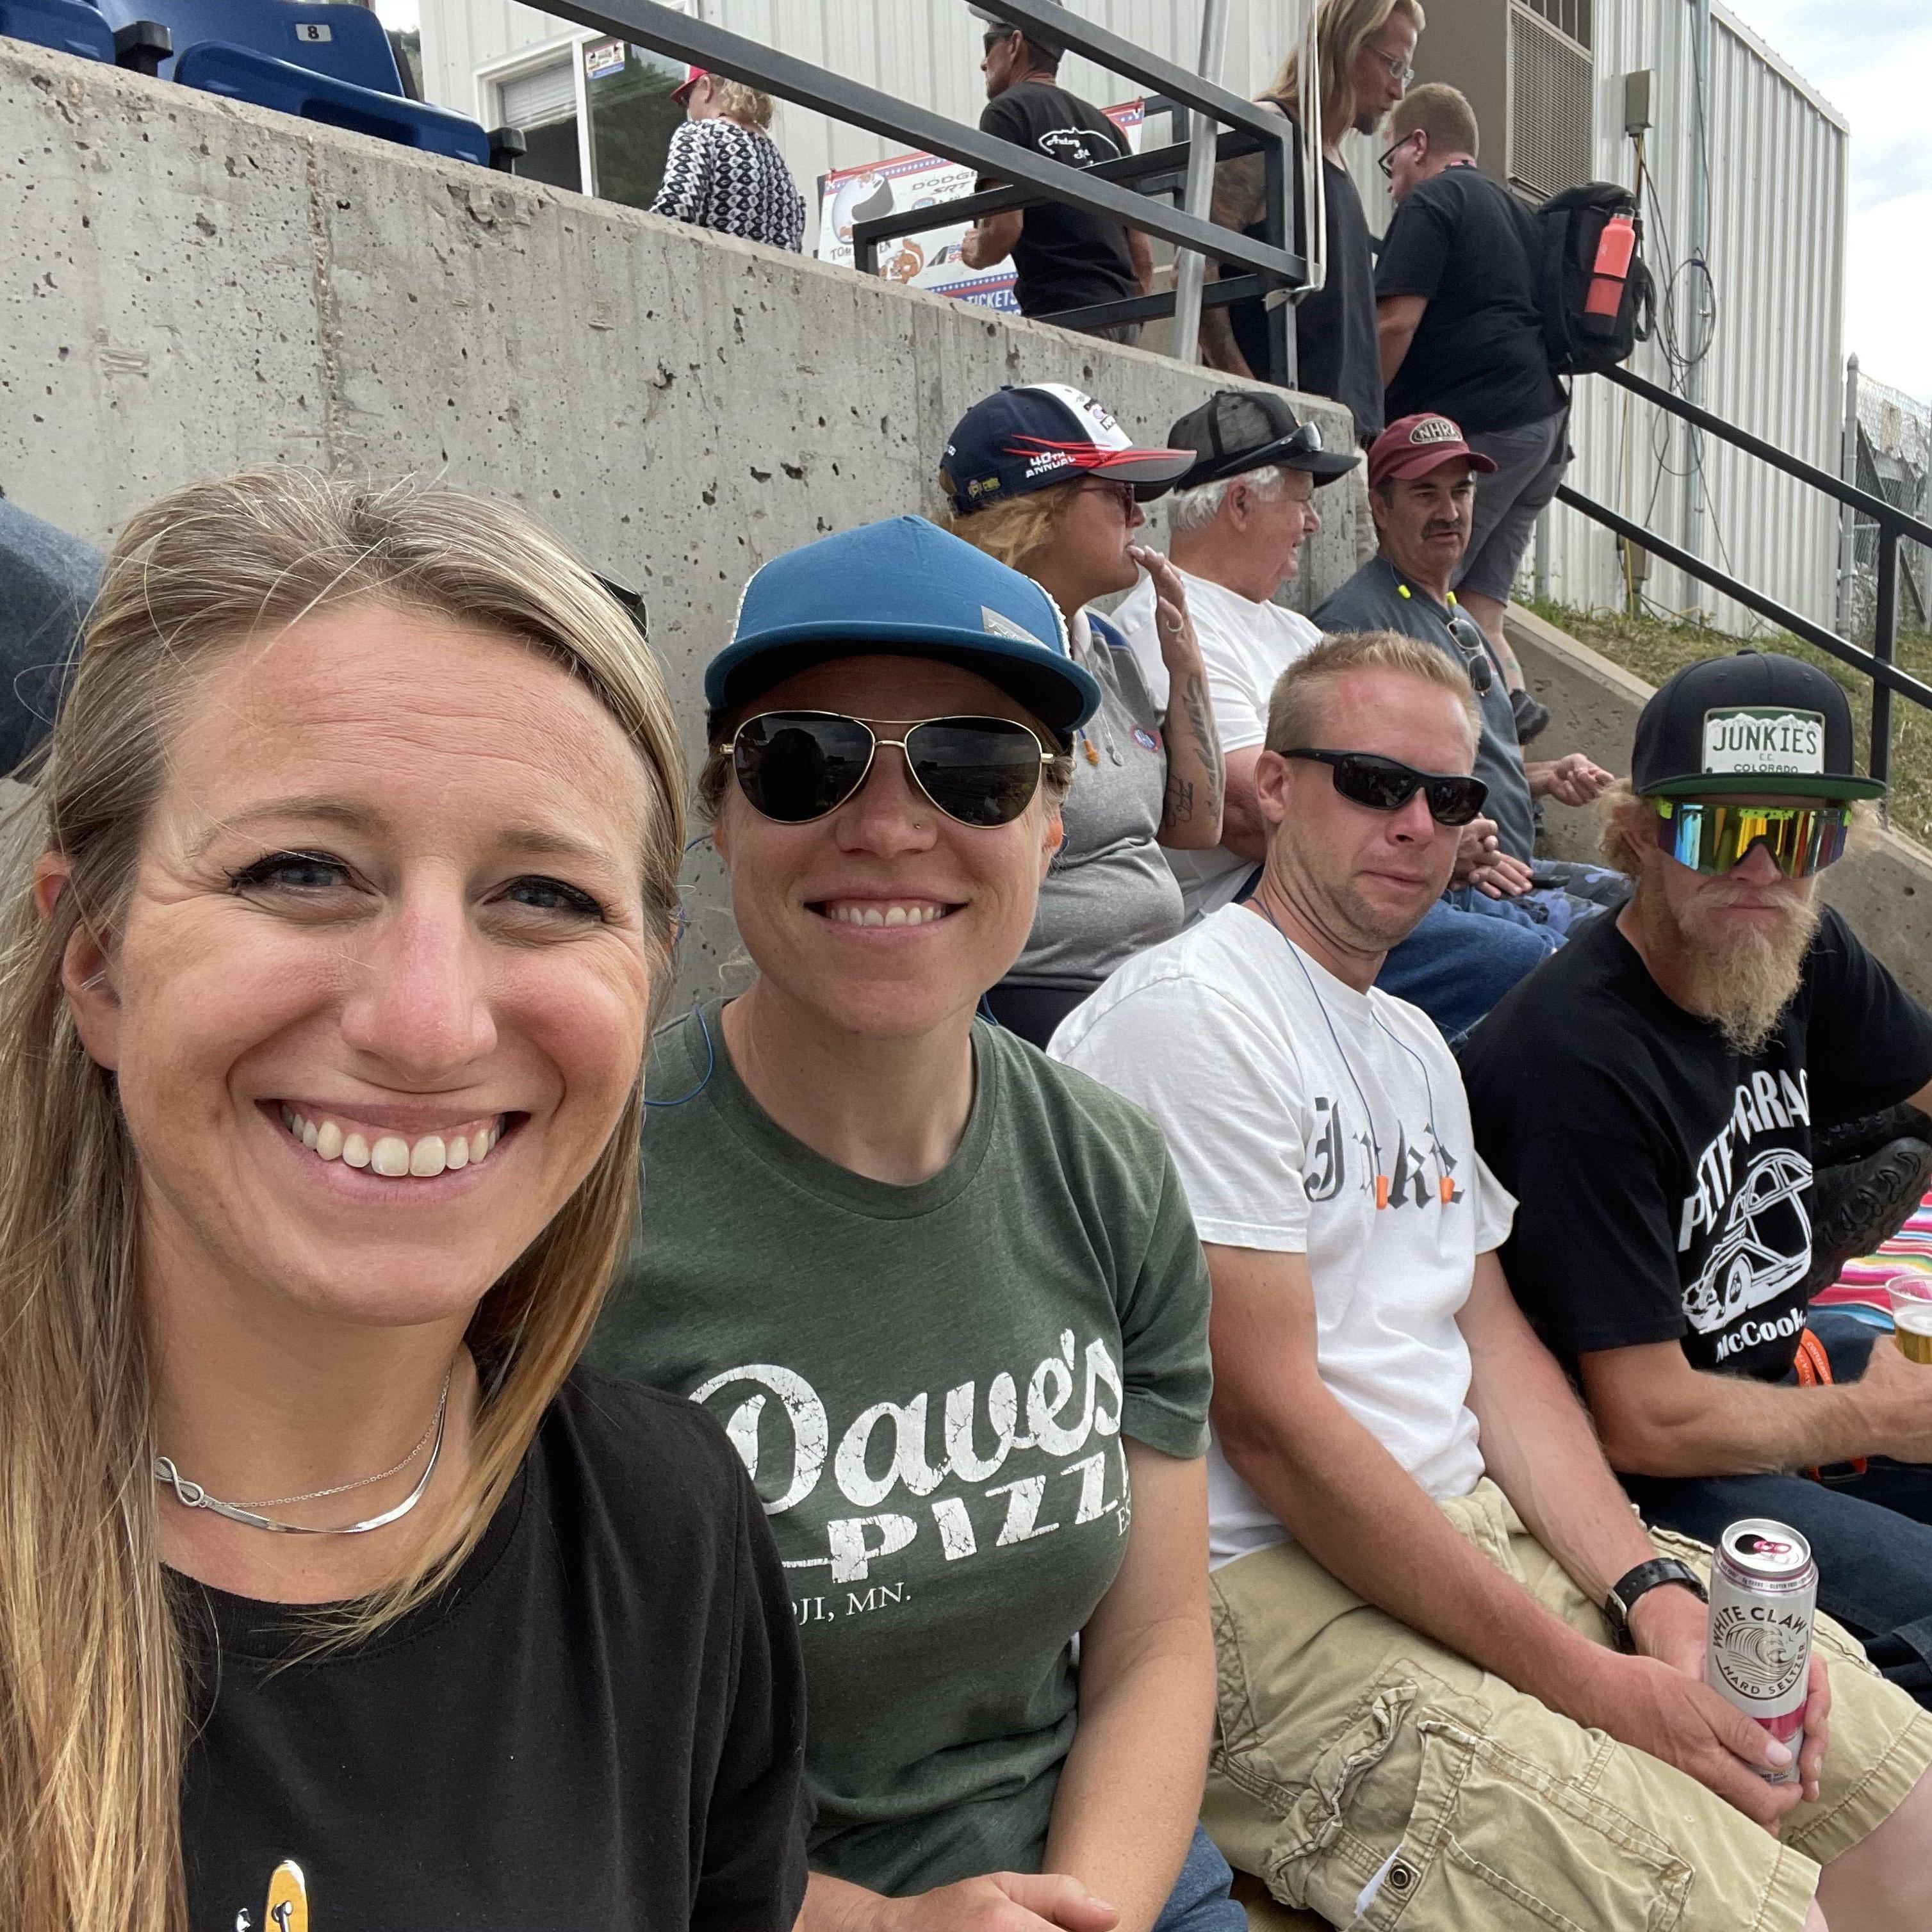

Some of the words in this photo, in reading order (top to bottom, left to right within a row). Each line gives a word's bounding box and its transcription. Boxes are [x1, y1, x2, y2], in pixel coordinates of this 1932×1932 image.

[307, 26, 319, 39] 8
[931, 180, 972, 195] SRT
[967, 290, 1019, 308] TICKETS
[1026, 455, 1076, 478] ANNUAL
[1030, 451, 1065, 466] 40TH
[1713, 726, 1817, 755] JUNKIES
[1733, 764, 1798, 773] COLORADO
[689, 1328, 1122, 1515] Dave's
[828, 1437, 1129, 1584] PIZZ
[791, 1596, 835, 1626] JI,
[846, 1582, 911, 1616] MN.
[1713, 1606, 1746, 1649] WHITE
[1751, 1607, 1807, 1635] CLAW
[1723, 1666, 1760, 1694] HARD
[1768, 1642, 1805, 1694] SELTZER
